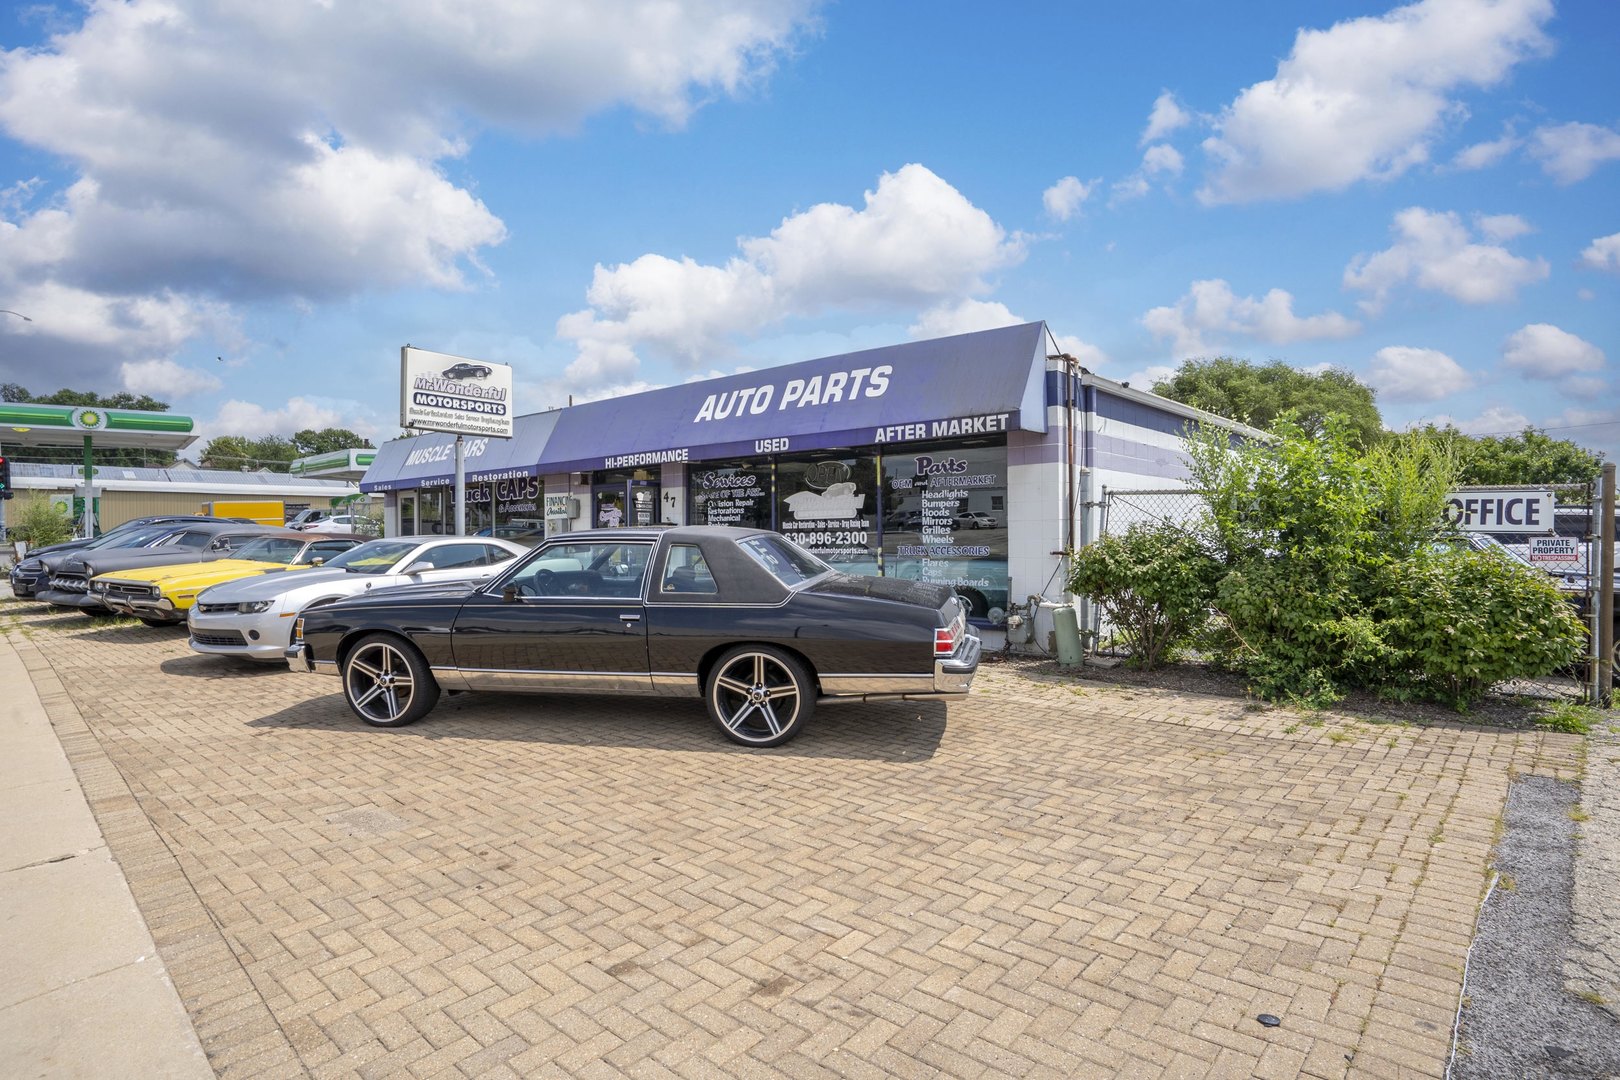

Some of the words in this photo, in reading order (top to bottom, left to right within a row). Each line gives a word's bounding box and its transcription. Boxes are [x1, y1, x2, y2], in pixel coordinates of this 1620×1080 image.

[693, 384, 775, 423] AUTO
[778, 365, 893, 411] PARTS
[415, 394, 505, 414] MOTORSPORTS
[412, 418, 508, 434] www.mrwonderfulmotorsports.com
[875, 424, 926, 443] AFTER
[932, 413, 1009, 438] MARKET
[405, 444, 454, 466] MUSCLE
[454, 438, 489, 459] ARS
[755, 438, 789, 454] USED
[605, 448, 689, 469] HI-PERFORMANCE
[914, 456, 968, 476] Parts
[421, 478, 450, 486] Service
[472, 470, 529, 482] Restoration
[702, 471, 757, 490] Services
[892, 478, 912, 490] OEM
[930, 474, 996, 488] AFTERMARKET
[450, 482, 490, 504] Tuck
[496, 478, 540, 500] CAPS
[922, 489, 968, 500] Headlights
[735, 498, 754, 507] Repair
[922, 499, 960, 510] Bumpers
[922, 508, 950, 517] Hoods
[1441, 498, 1540, 526] OFFICE
[922, 517, 953, 526] Mirrors
[784, 531, 868, 544] 630-896-2300
[922, 526, 951, 535] Grilles
[922, 534, 955, 544] Wheels
[897, 546, 928, 558] TRUCK
[928, 545, 990, 557] ACCESSORIES
[922, 558, 949, 568] Flares
[922, 567, 942, 577] Caps
[922, 577, 958, 588] Running
[958, 577, 990, 587] Boards
